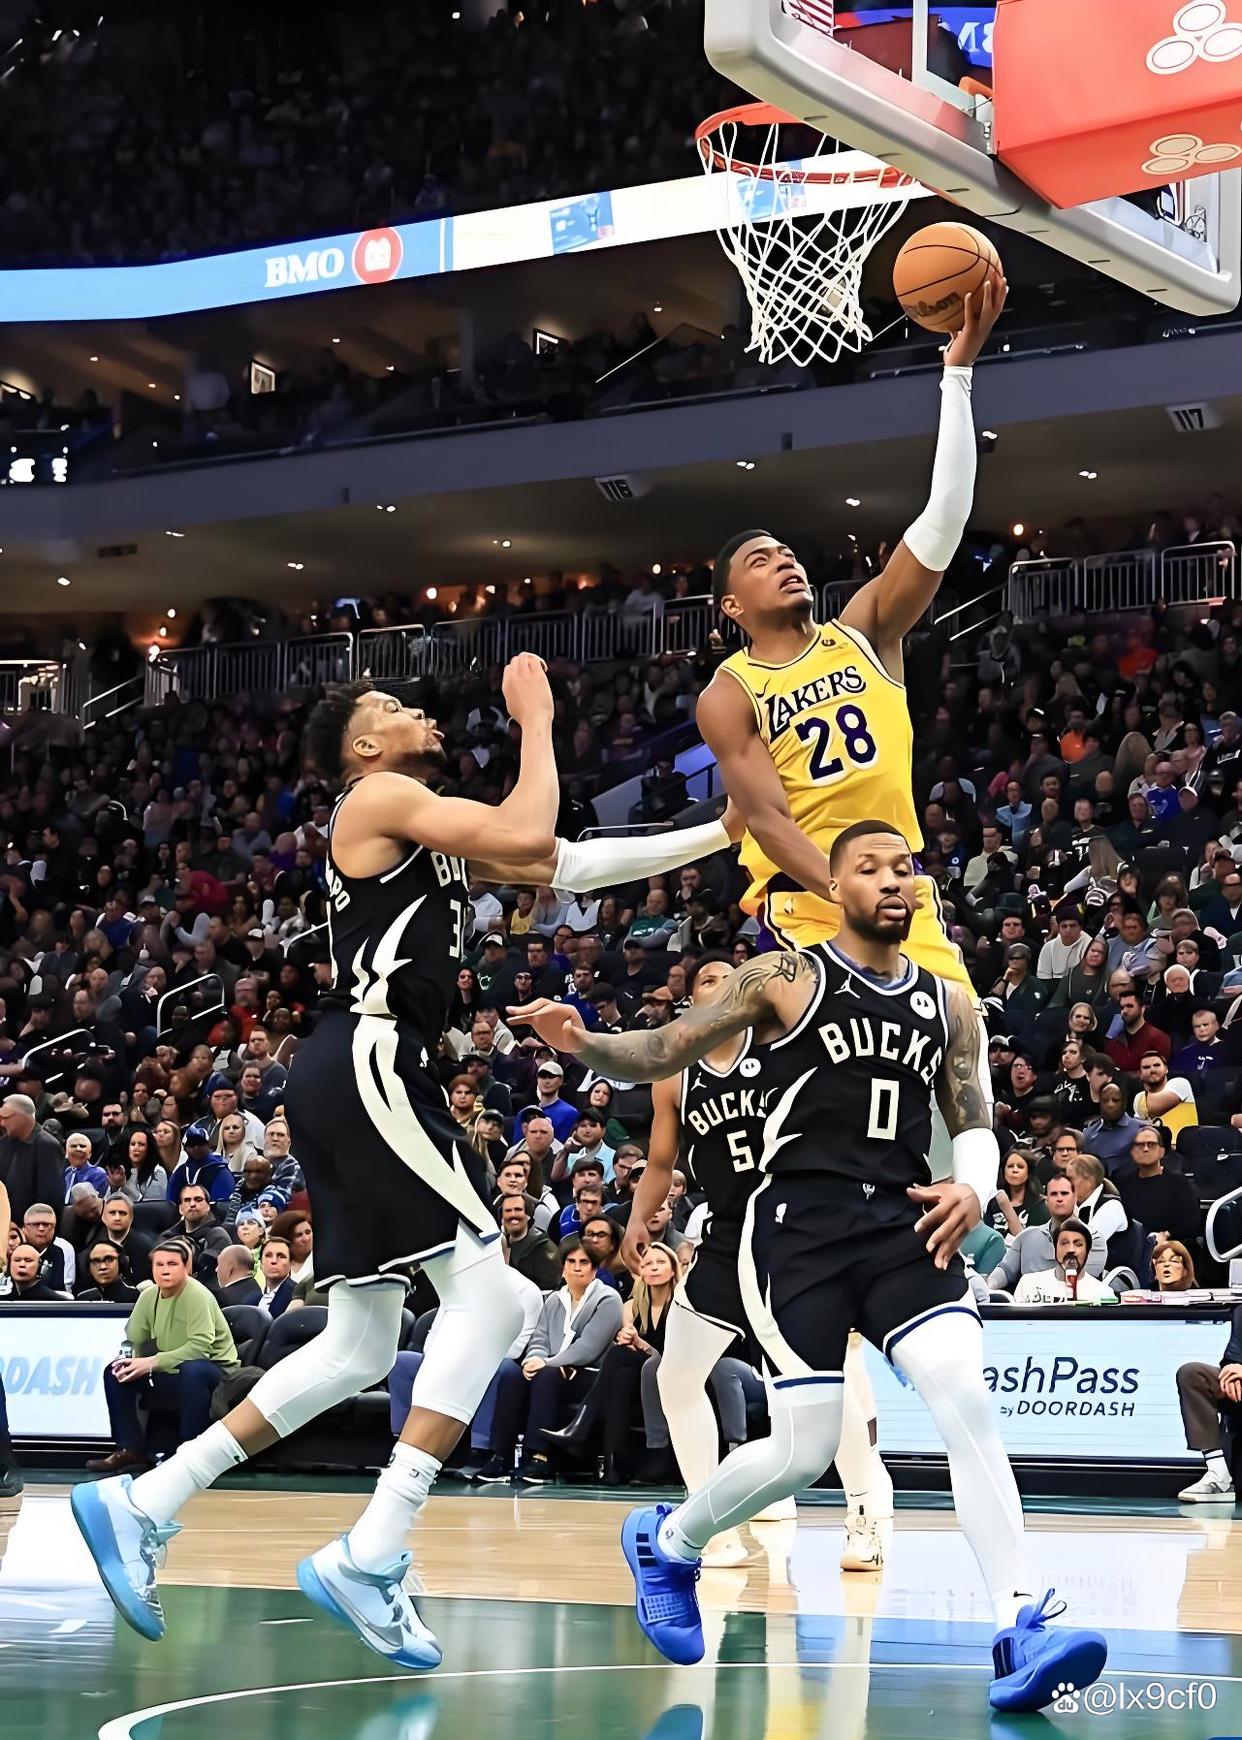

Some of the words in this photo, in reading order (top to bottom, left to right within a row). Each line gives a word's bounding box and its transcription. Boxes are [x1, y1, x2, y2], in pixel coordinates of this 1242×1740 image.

[264, 248, 345, 288] BMO
[1173, 408, 1204, 430] 117
[765, 665, 866, 744] LAKERS
[794, 703, 877, 780] 28
[817, 1017, 943, 1086] BUCKS
[866, 1077, 900, 1141] 0
[726, 1129, 755, 1173] 5
[0, 1356, 103, 1396] DASH
[982, 1356, 1140, 1394] ashPass
[1017, 1400, 1136, 1417] DOORDASH
